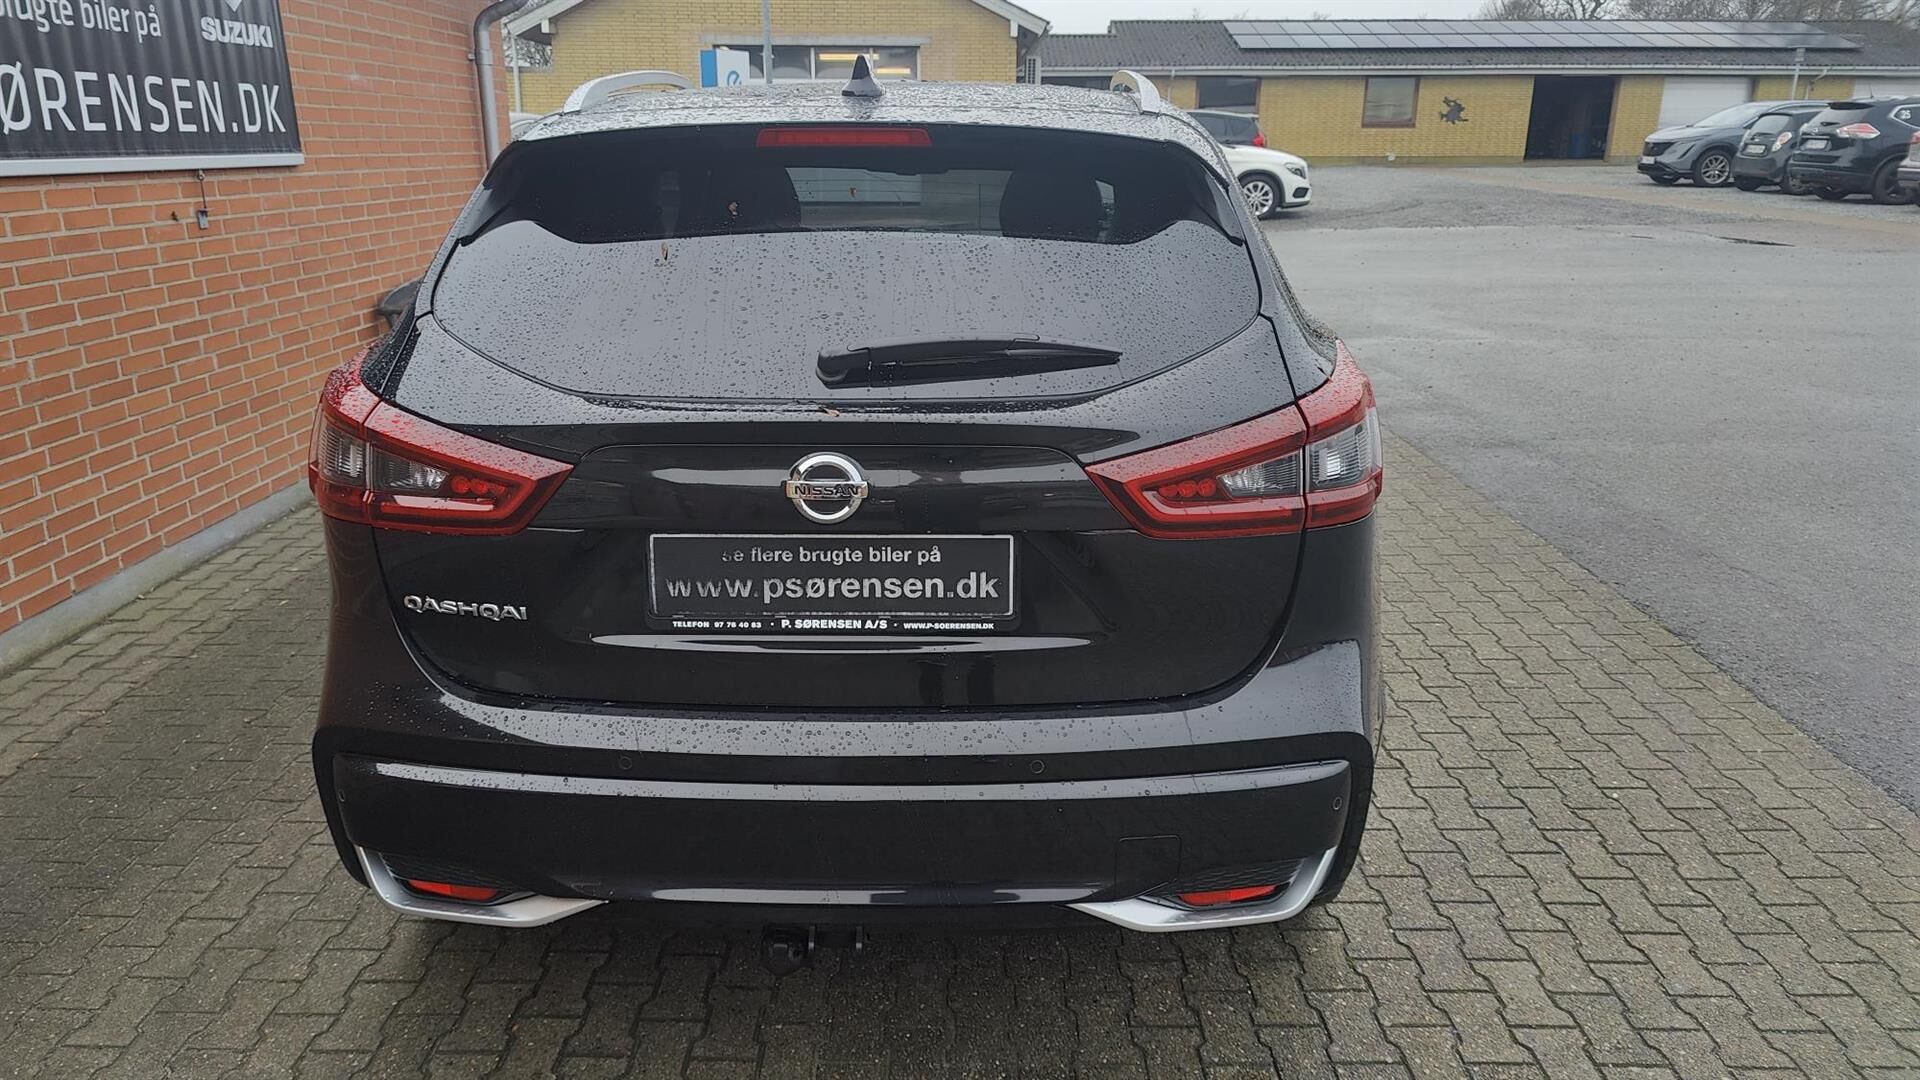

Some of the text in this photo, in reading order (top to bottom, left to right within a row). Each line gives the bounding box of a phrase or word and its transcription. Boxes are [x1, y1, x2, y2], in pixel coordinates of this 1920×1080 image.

[0, 0, 162, 43] rugte biler på
[201, 16, 274, 48] SUZUKI
[0, 61, 287, 135] ØRENSEN.DK
[794, 484, 860, 497] NISSAN
[751, 547, 793, 562] flere
[799, 547, 863, 566] brugte
[869, 547, 912, 562] biler
[918, 547, 942, 566] på
[403, 595, 527, 621] QASHQAI
[672, 620, 710, 629] TELEFON
[714, 620, 724, 629] 97
[738, 620, 750, 629] 40
[781, 619, 792, 629] P.
[794, 618, 862, 629] SØRENSEN
[864, 619, 888, 629] A/S
